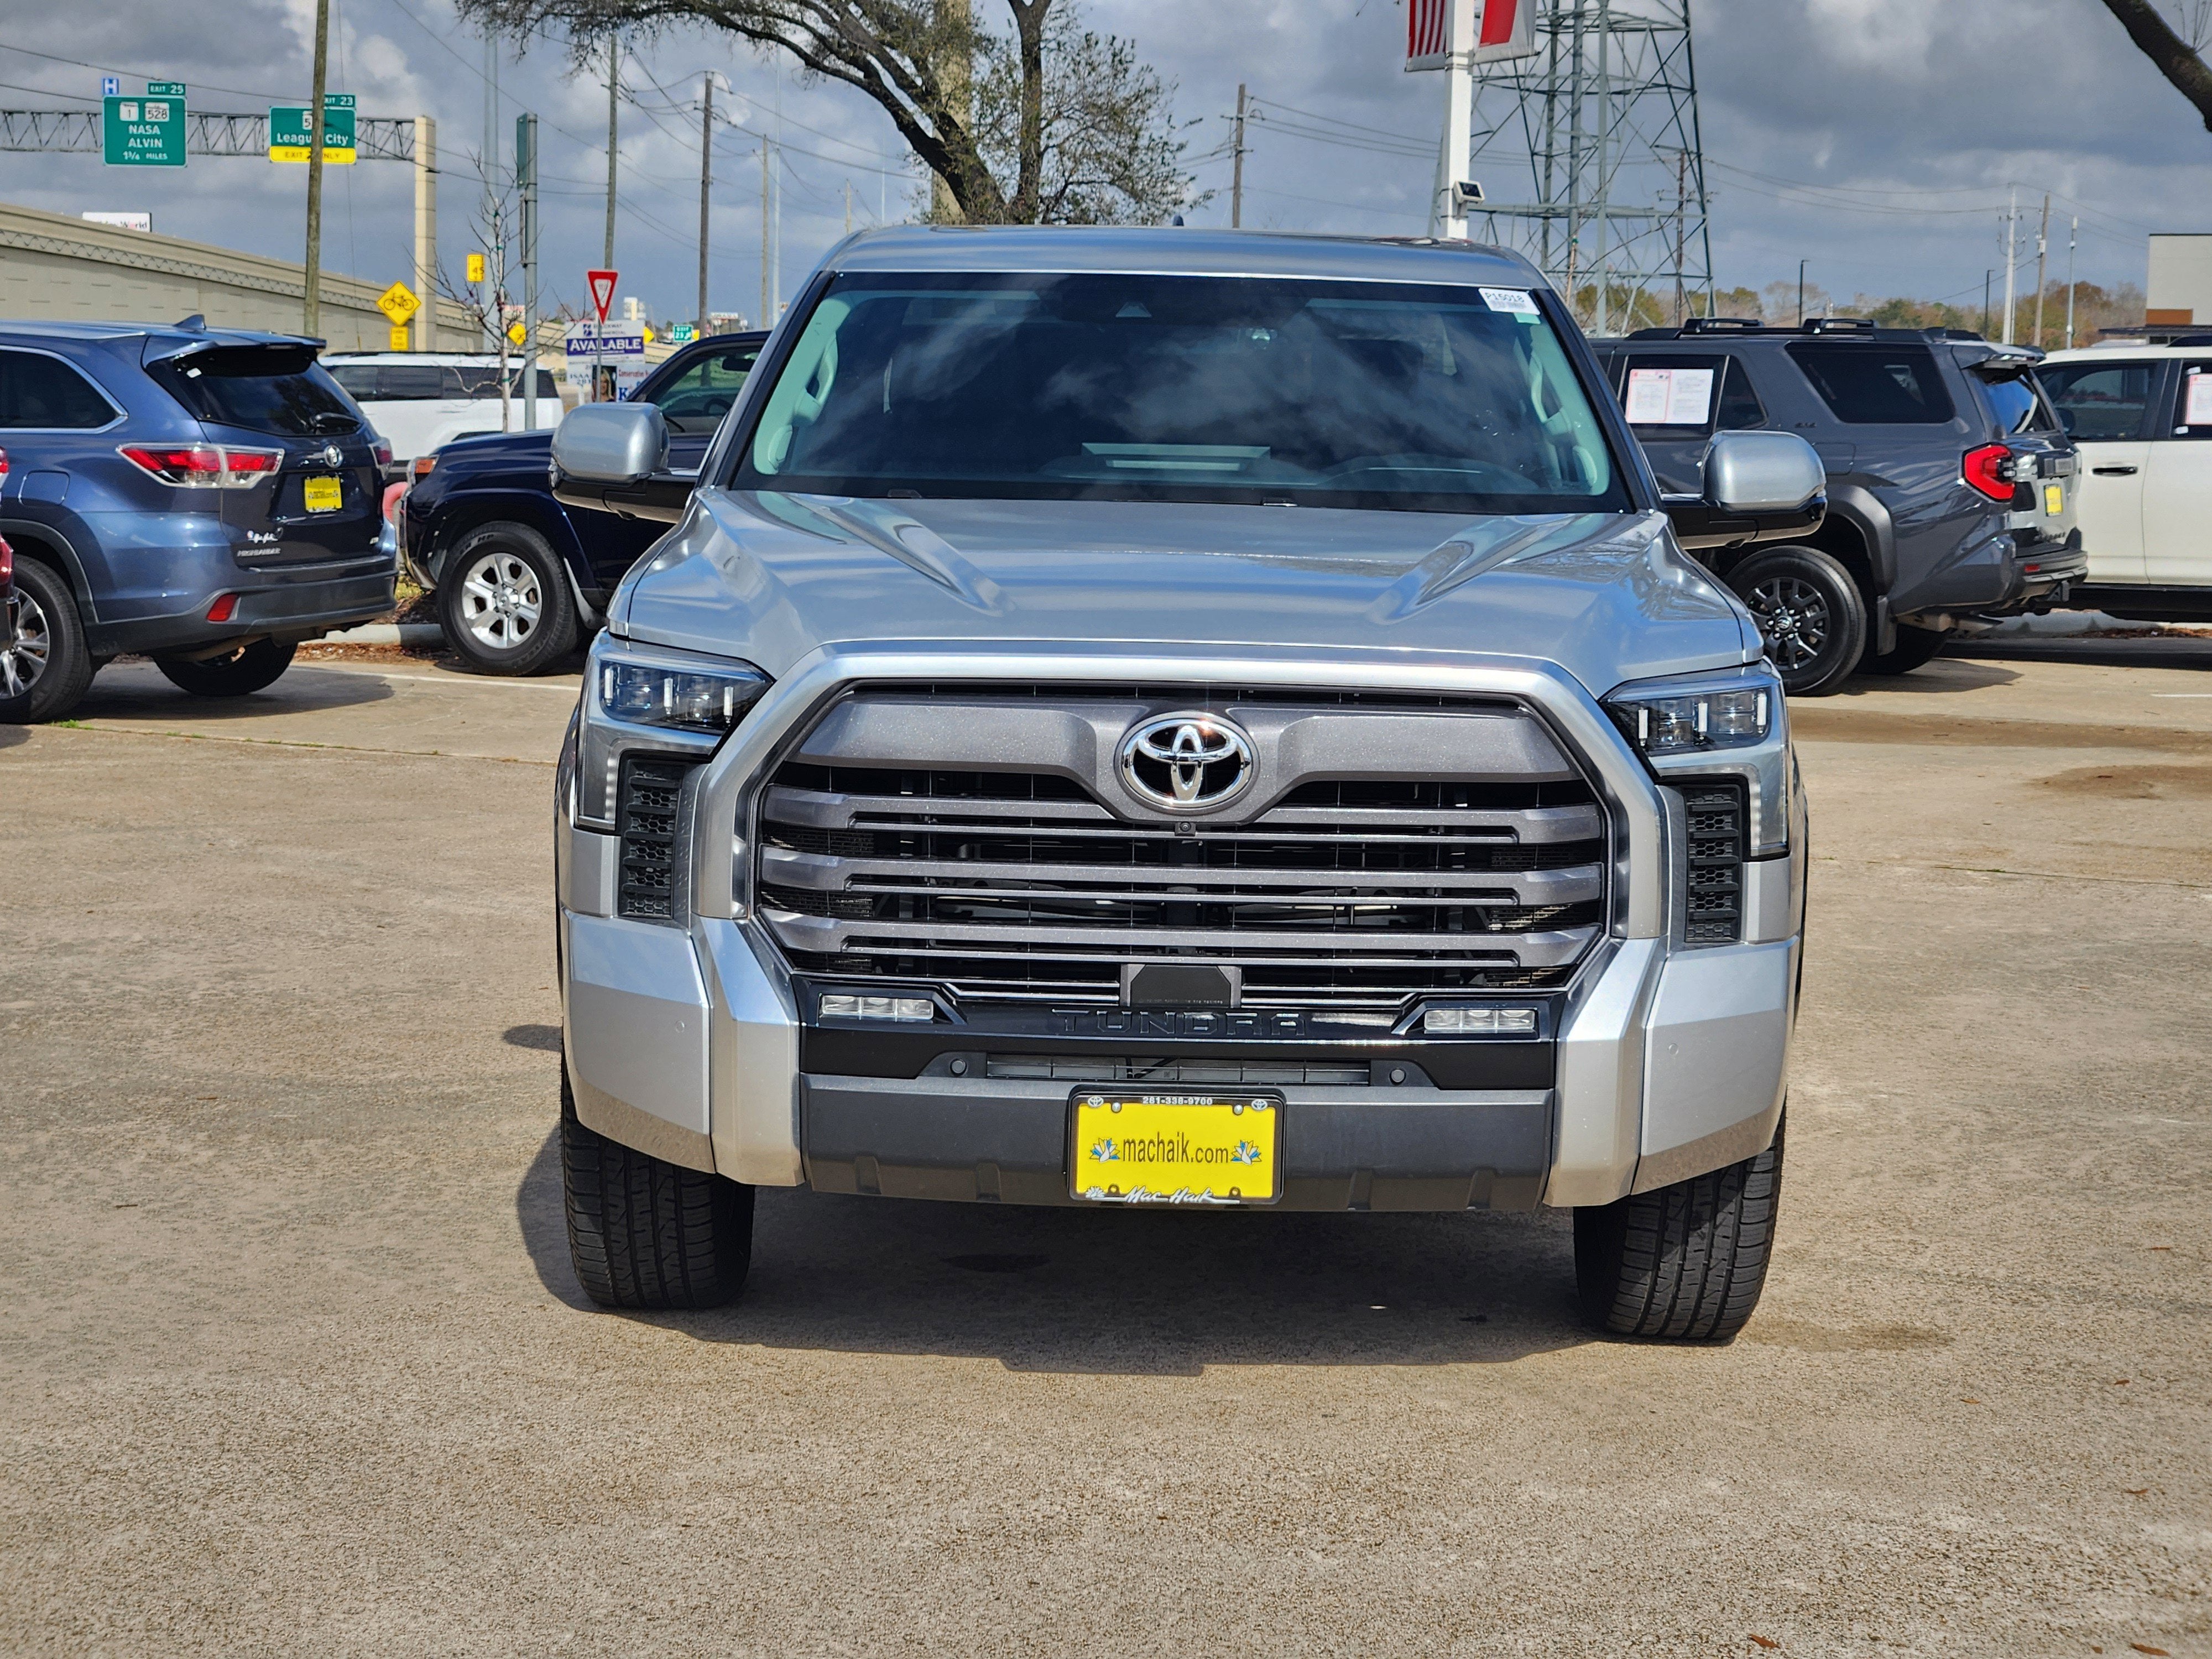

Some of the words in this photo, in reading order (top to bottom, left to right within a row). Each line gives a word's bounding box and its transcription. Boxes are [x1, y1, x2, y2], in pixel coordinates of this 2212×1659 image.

[170, 85, 184, 94] 25
[340, 96, 353, 106] 23
[148, 109, 168, 119] 528
[128, 124, 161, 134] NASA
[128, 138, 163, 148] ALVIN
[276, 133, 312, 145] Leagu
[325, 133, 348, 147] City
[570, 338, 641, 352] AVAILABLE
[1052, 1008, 1306, 1036] TUNDRA
[1123, 1131, 1229, 1164] machaik.com
[1124, 1185, 1162, 1203] Mac
